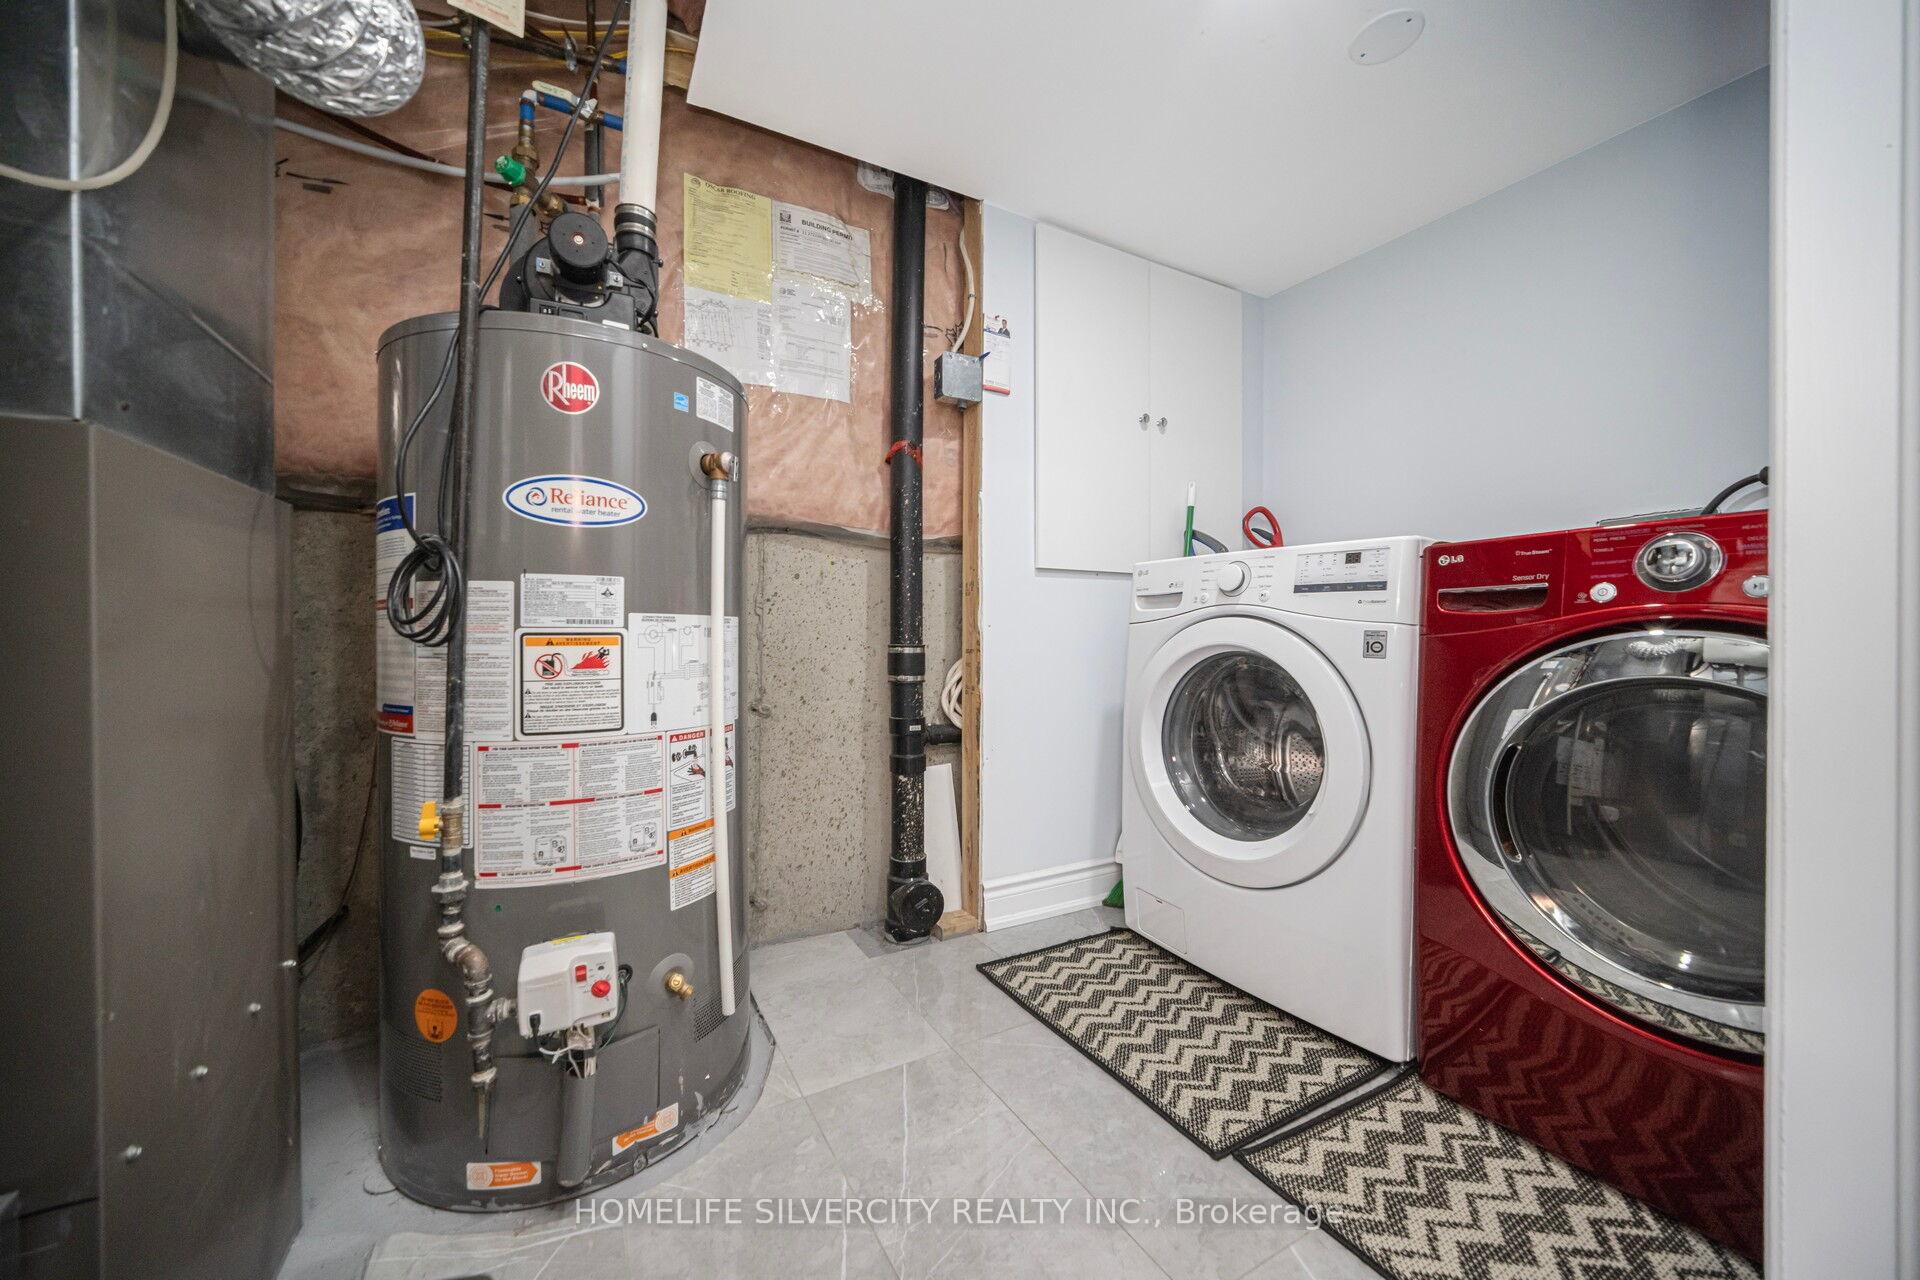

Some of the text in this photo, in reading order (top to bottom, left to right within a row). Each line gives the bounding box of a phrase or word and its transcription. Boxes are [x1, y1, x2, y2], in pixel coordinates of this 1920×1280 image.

[801, 219, 831, 233] BUILDING
[548, 362, 596, 406] Rheem
[550, 487, 628, 510] Reiance
[551, 506, 573, 514] rental
[597, 508, 621, 518] heater
[1450, 554, 1464, 564] LG
[1512, 573, 1550, 582] Sensor Dry
[678, 732, 704, 742] DANGER
